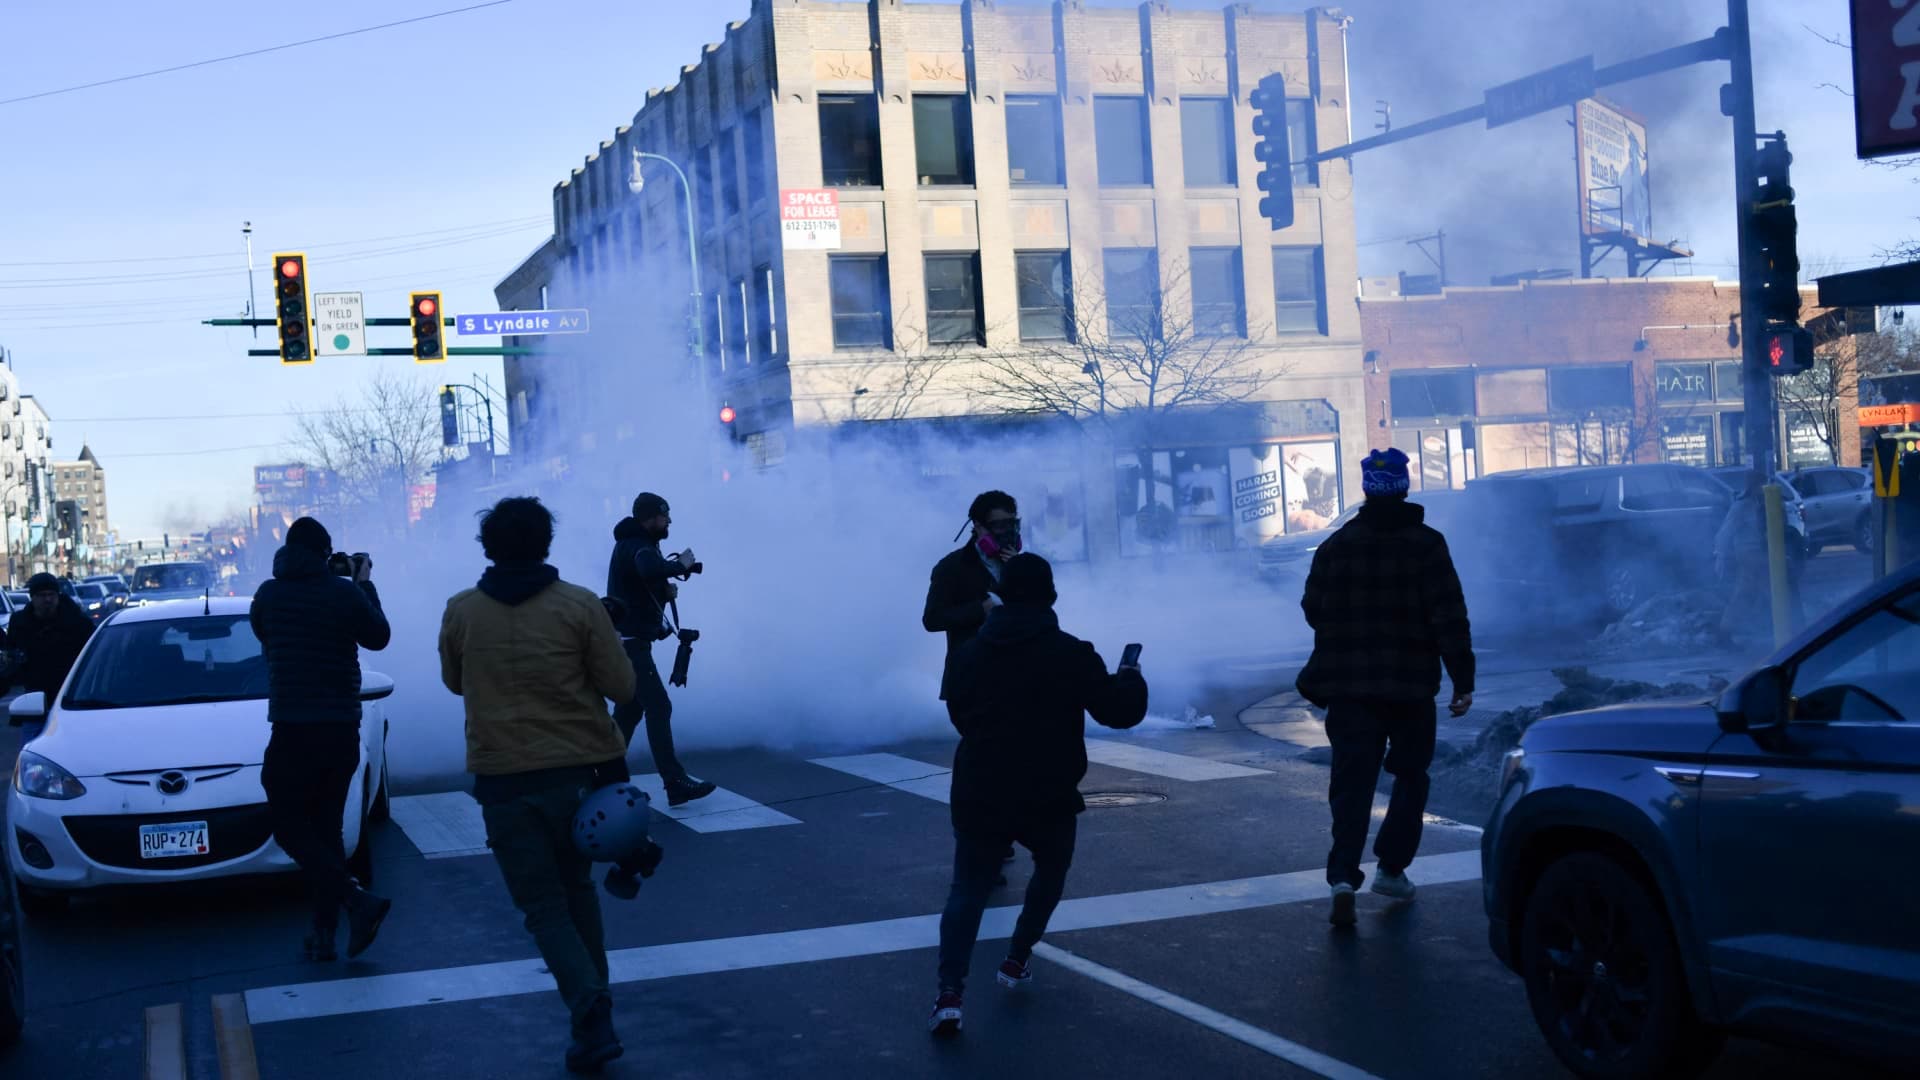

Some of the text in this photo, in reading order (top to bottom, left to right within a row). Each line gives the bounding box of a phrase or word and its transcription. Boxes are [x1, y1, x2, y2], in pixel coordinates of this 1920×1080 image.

[1590, 155, 1609, 183] Blue
[790, 192, 832, 204] SPACE
[785, 205, 837, 217] FOR LEASE
[318, 296, 359, 306] LEFT TURN
[328, 309, 352, 319] YIELD
[321, 322, 359, 332] ON GREEN
[464, 316, 579, 333] S Lyndale Av
[1655, 375, 1705, 392] HAIR
[1238, 472, 1275, 490] HARAZ
[1236, 487, 1279, 507] COMING
[1244, 504, 1274, 521] SOON
[143, 830, 204, 850] RUP 274
